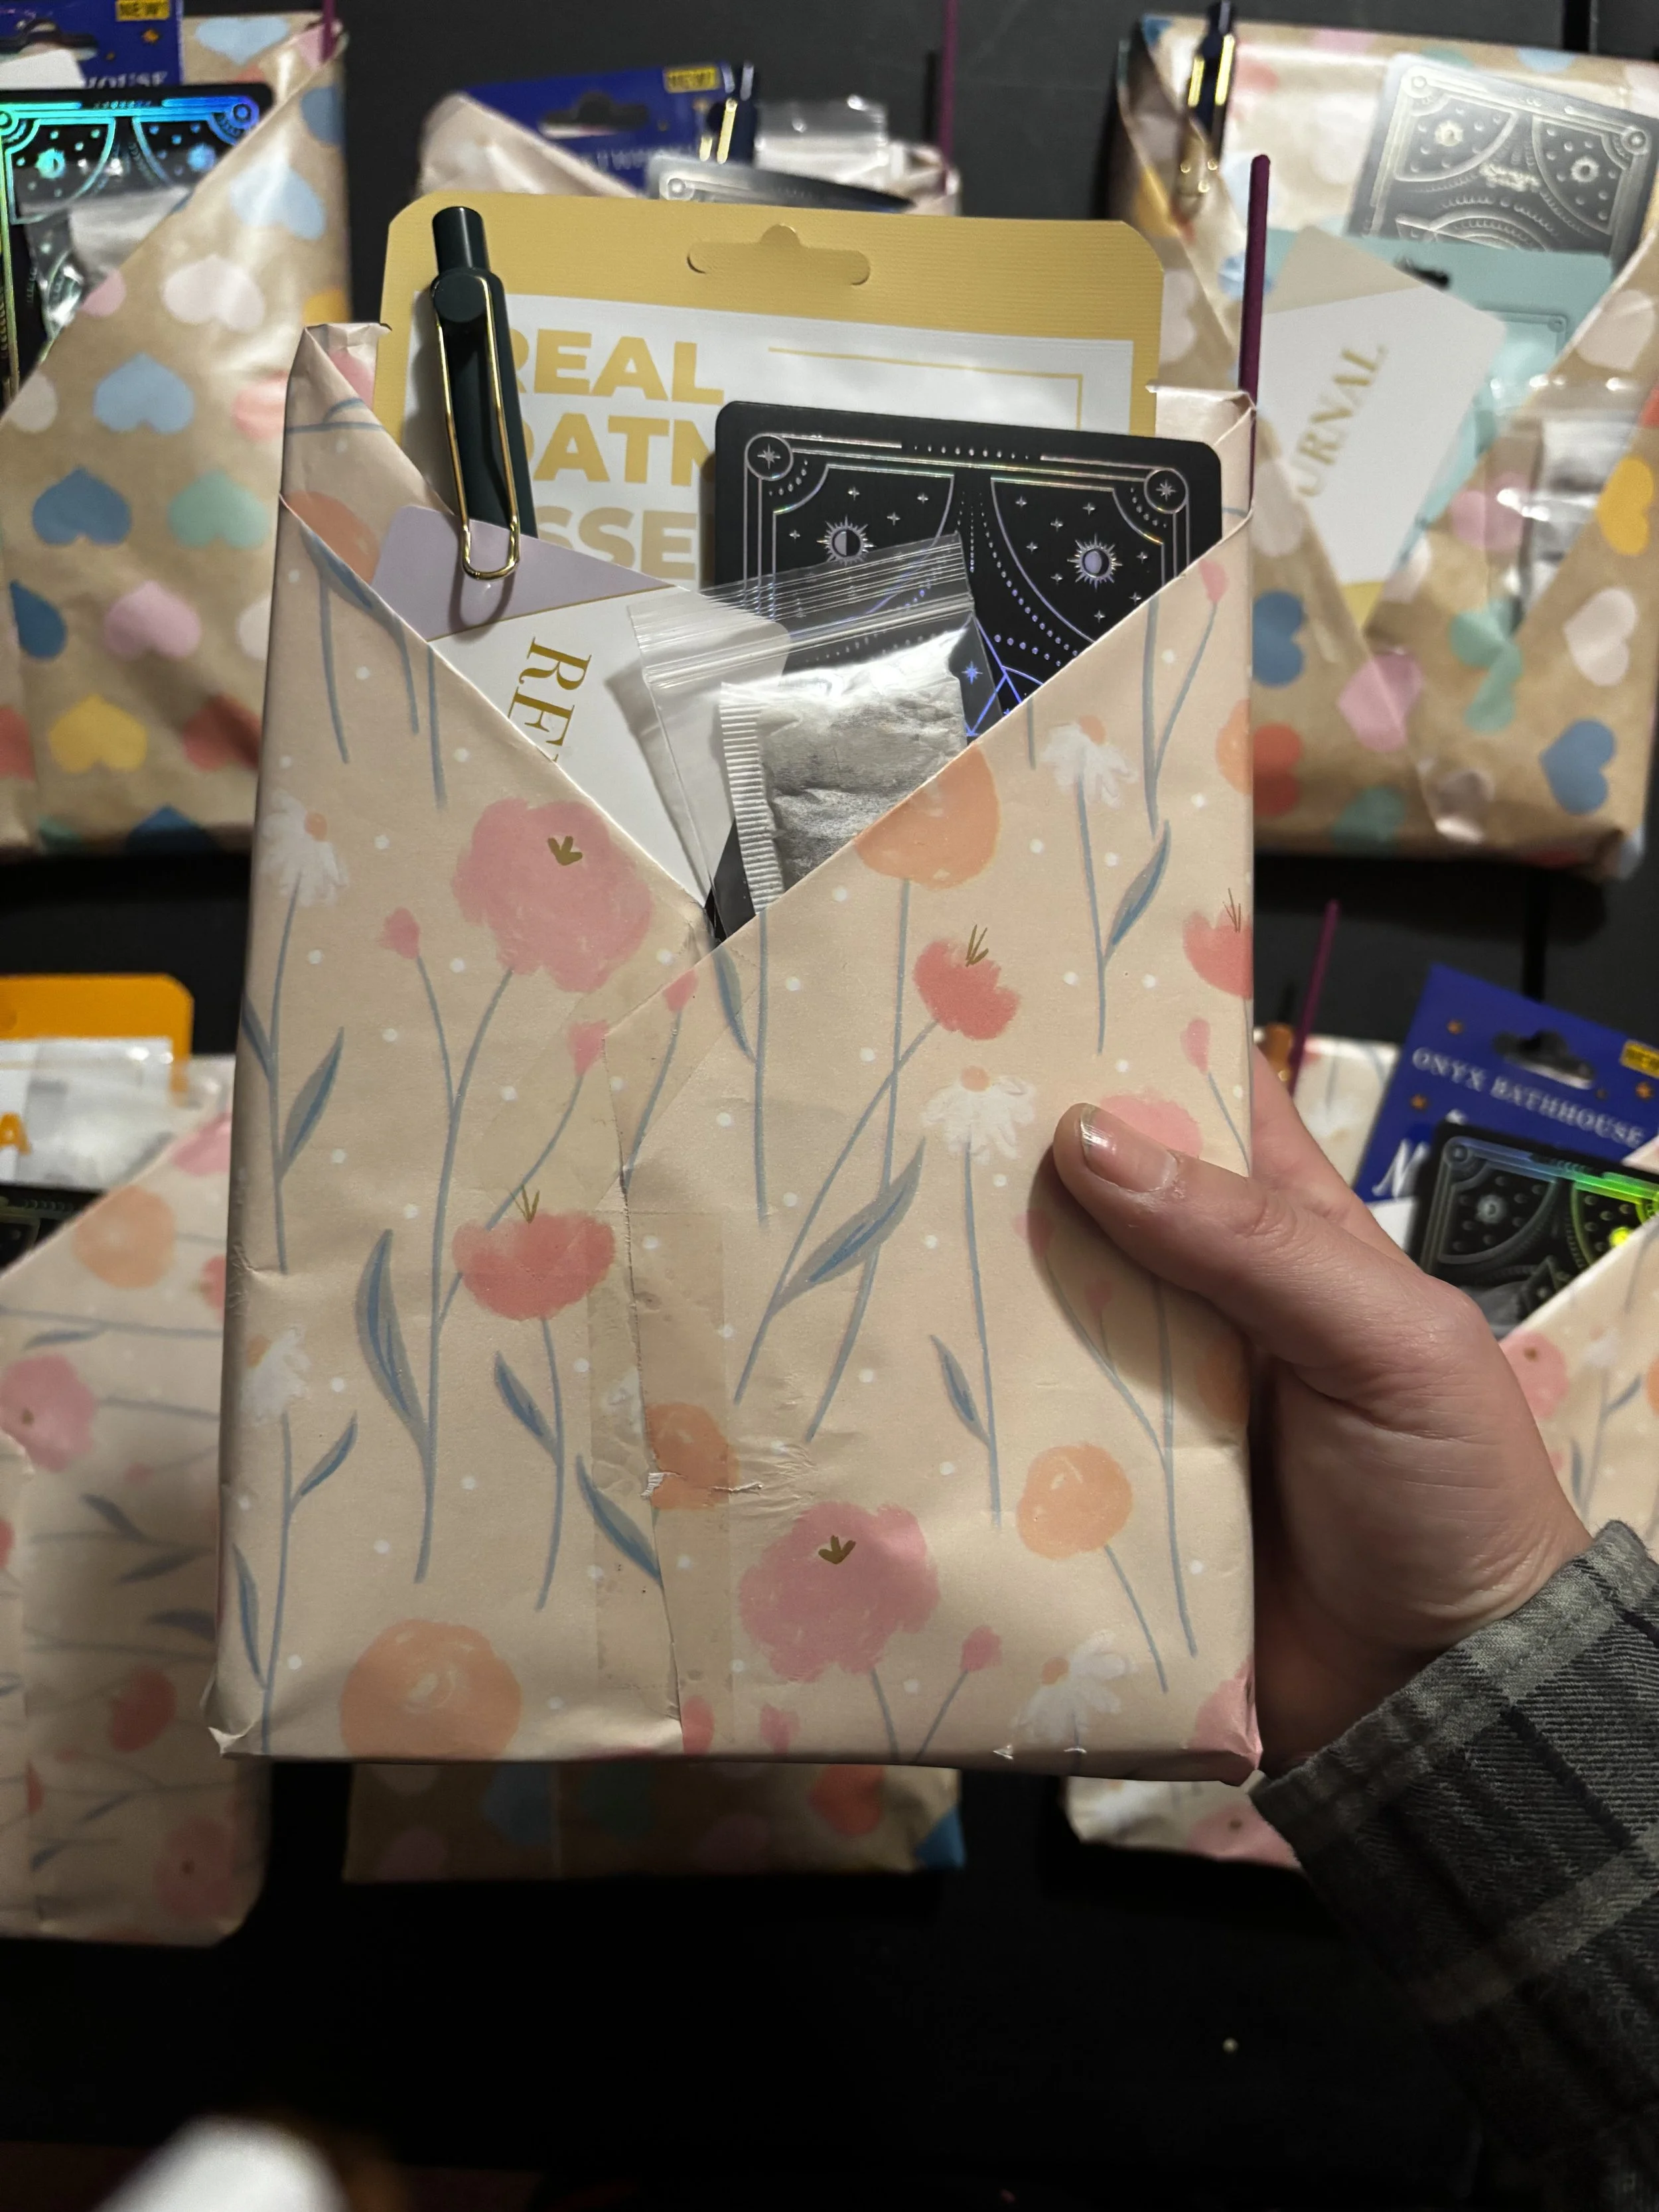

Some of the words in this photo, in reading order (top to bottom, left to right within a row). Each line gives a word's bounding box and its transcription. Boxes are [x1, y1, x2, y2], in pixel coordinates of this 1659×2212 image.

[507, 636, 592, 763] RE
[1412, 1047, 1486, 1092] ONYX
[1490, 1076, 1646, 1149] BATHHOUSE
